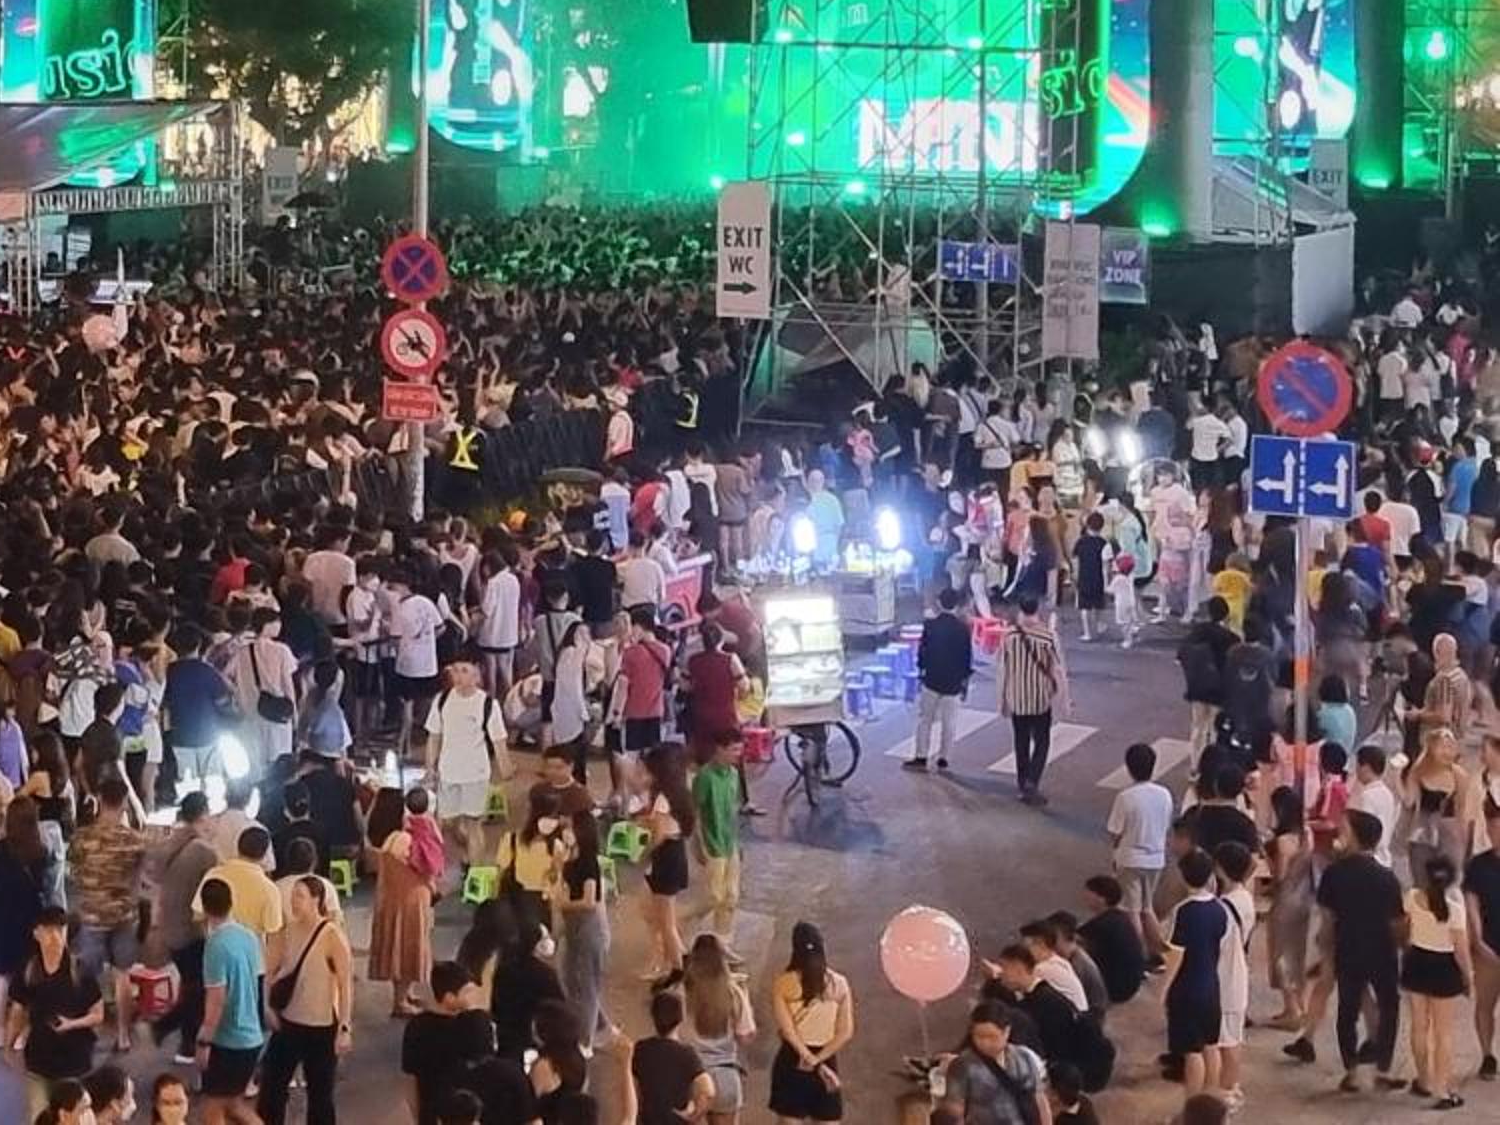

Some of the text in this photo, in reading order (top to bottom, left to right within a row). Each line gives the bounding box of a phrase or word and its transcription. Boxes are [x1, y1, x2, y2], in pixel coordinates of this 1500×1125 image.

[723, 227, 763, 248] EXIT
[728, 256, 754, 275] WC
[1113, 250, 1138, 266] VIP
[1103, 266, 1142, 284] ZONE
